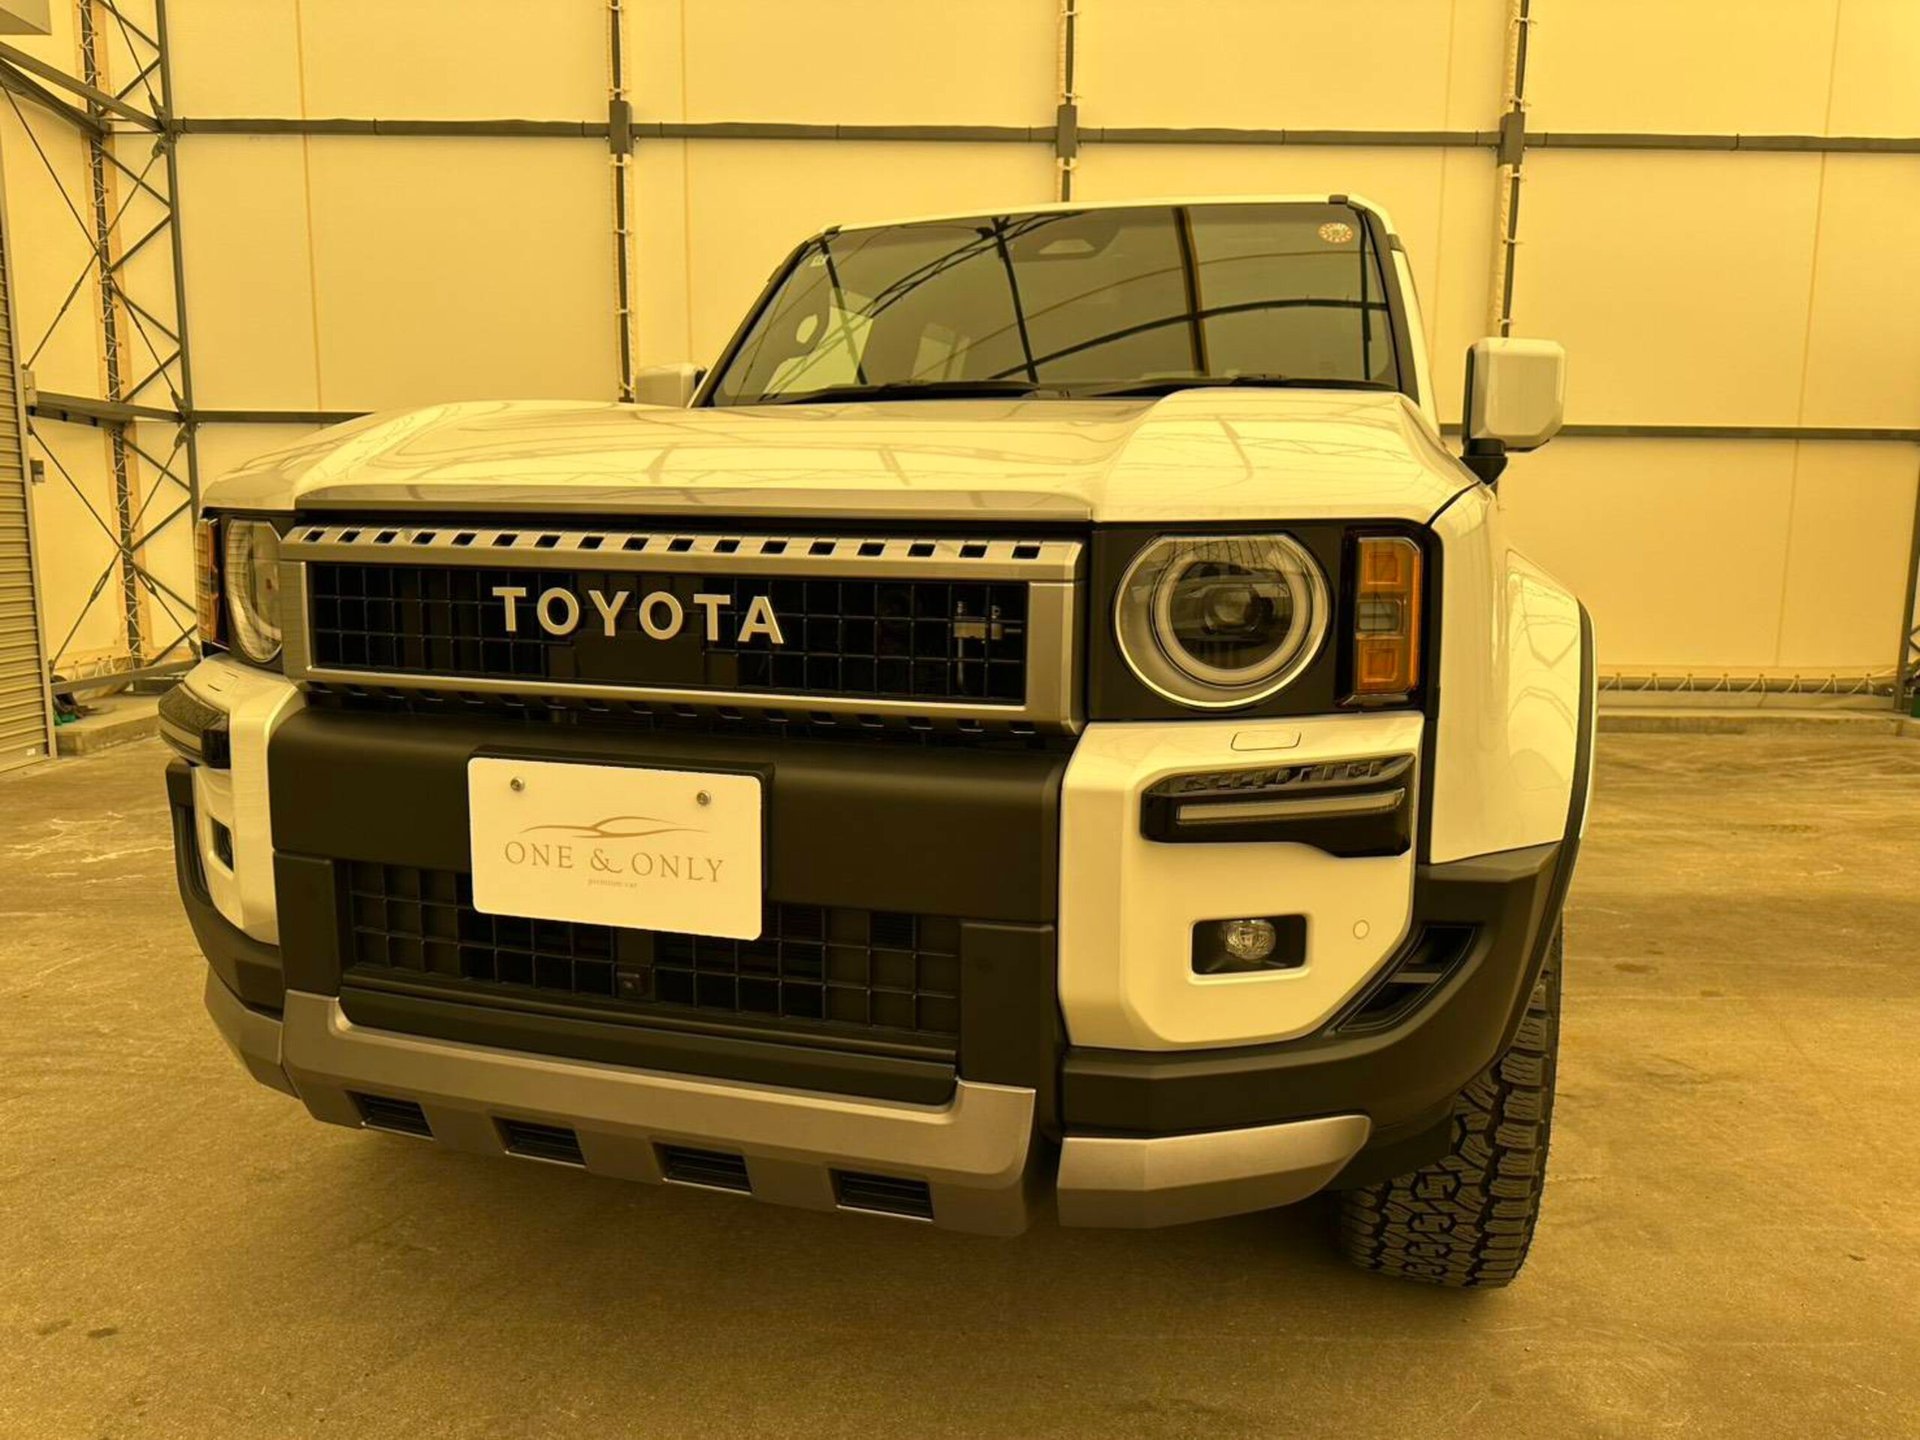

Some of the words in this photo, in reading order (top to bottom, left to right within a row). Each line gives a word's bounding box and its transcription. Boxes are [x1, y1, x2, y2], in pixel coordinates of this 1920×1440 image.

[492, 587, 785, 645] TOYOTA
[504, 841, 574, 869] ONE
[590, 848, 623, 874] &
[631, 852, 724, 882] ONLY
